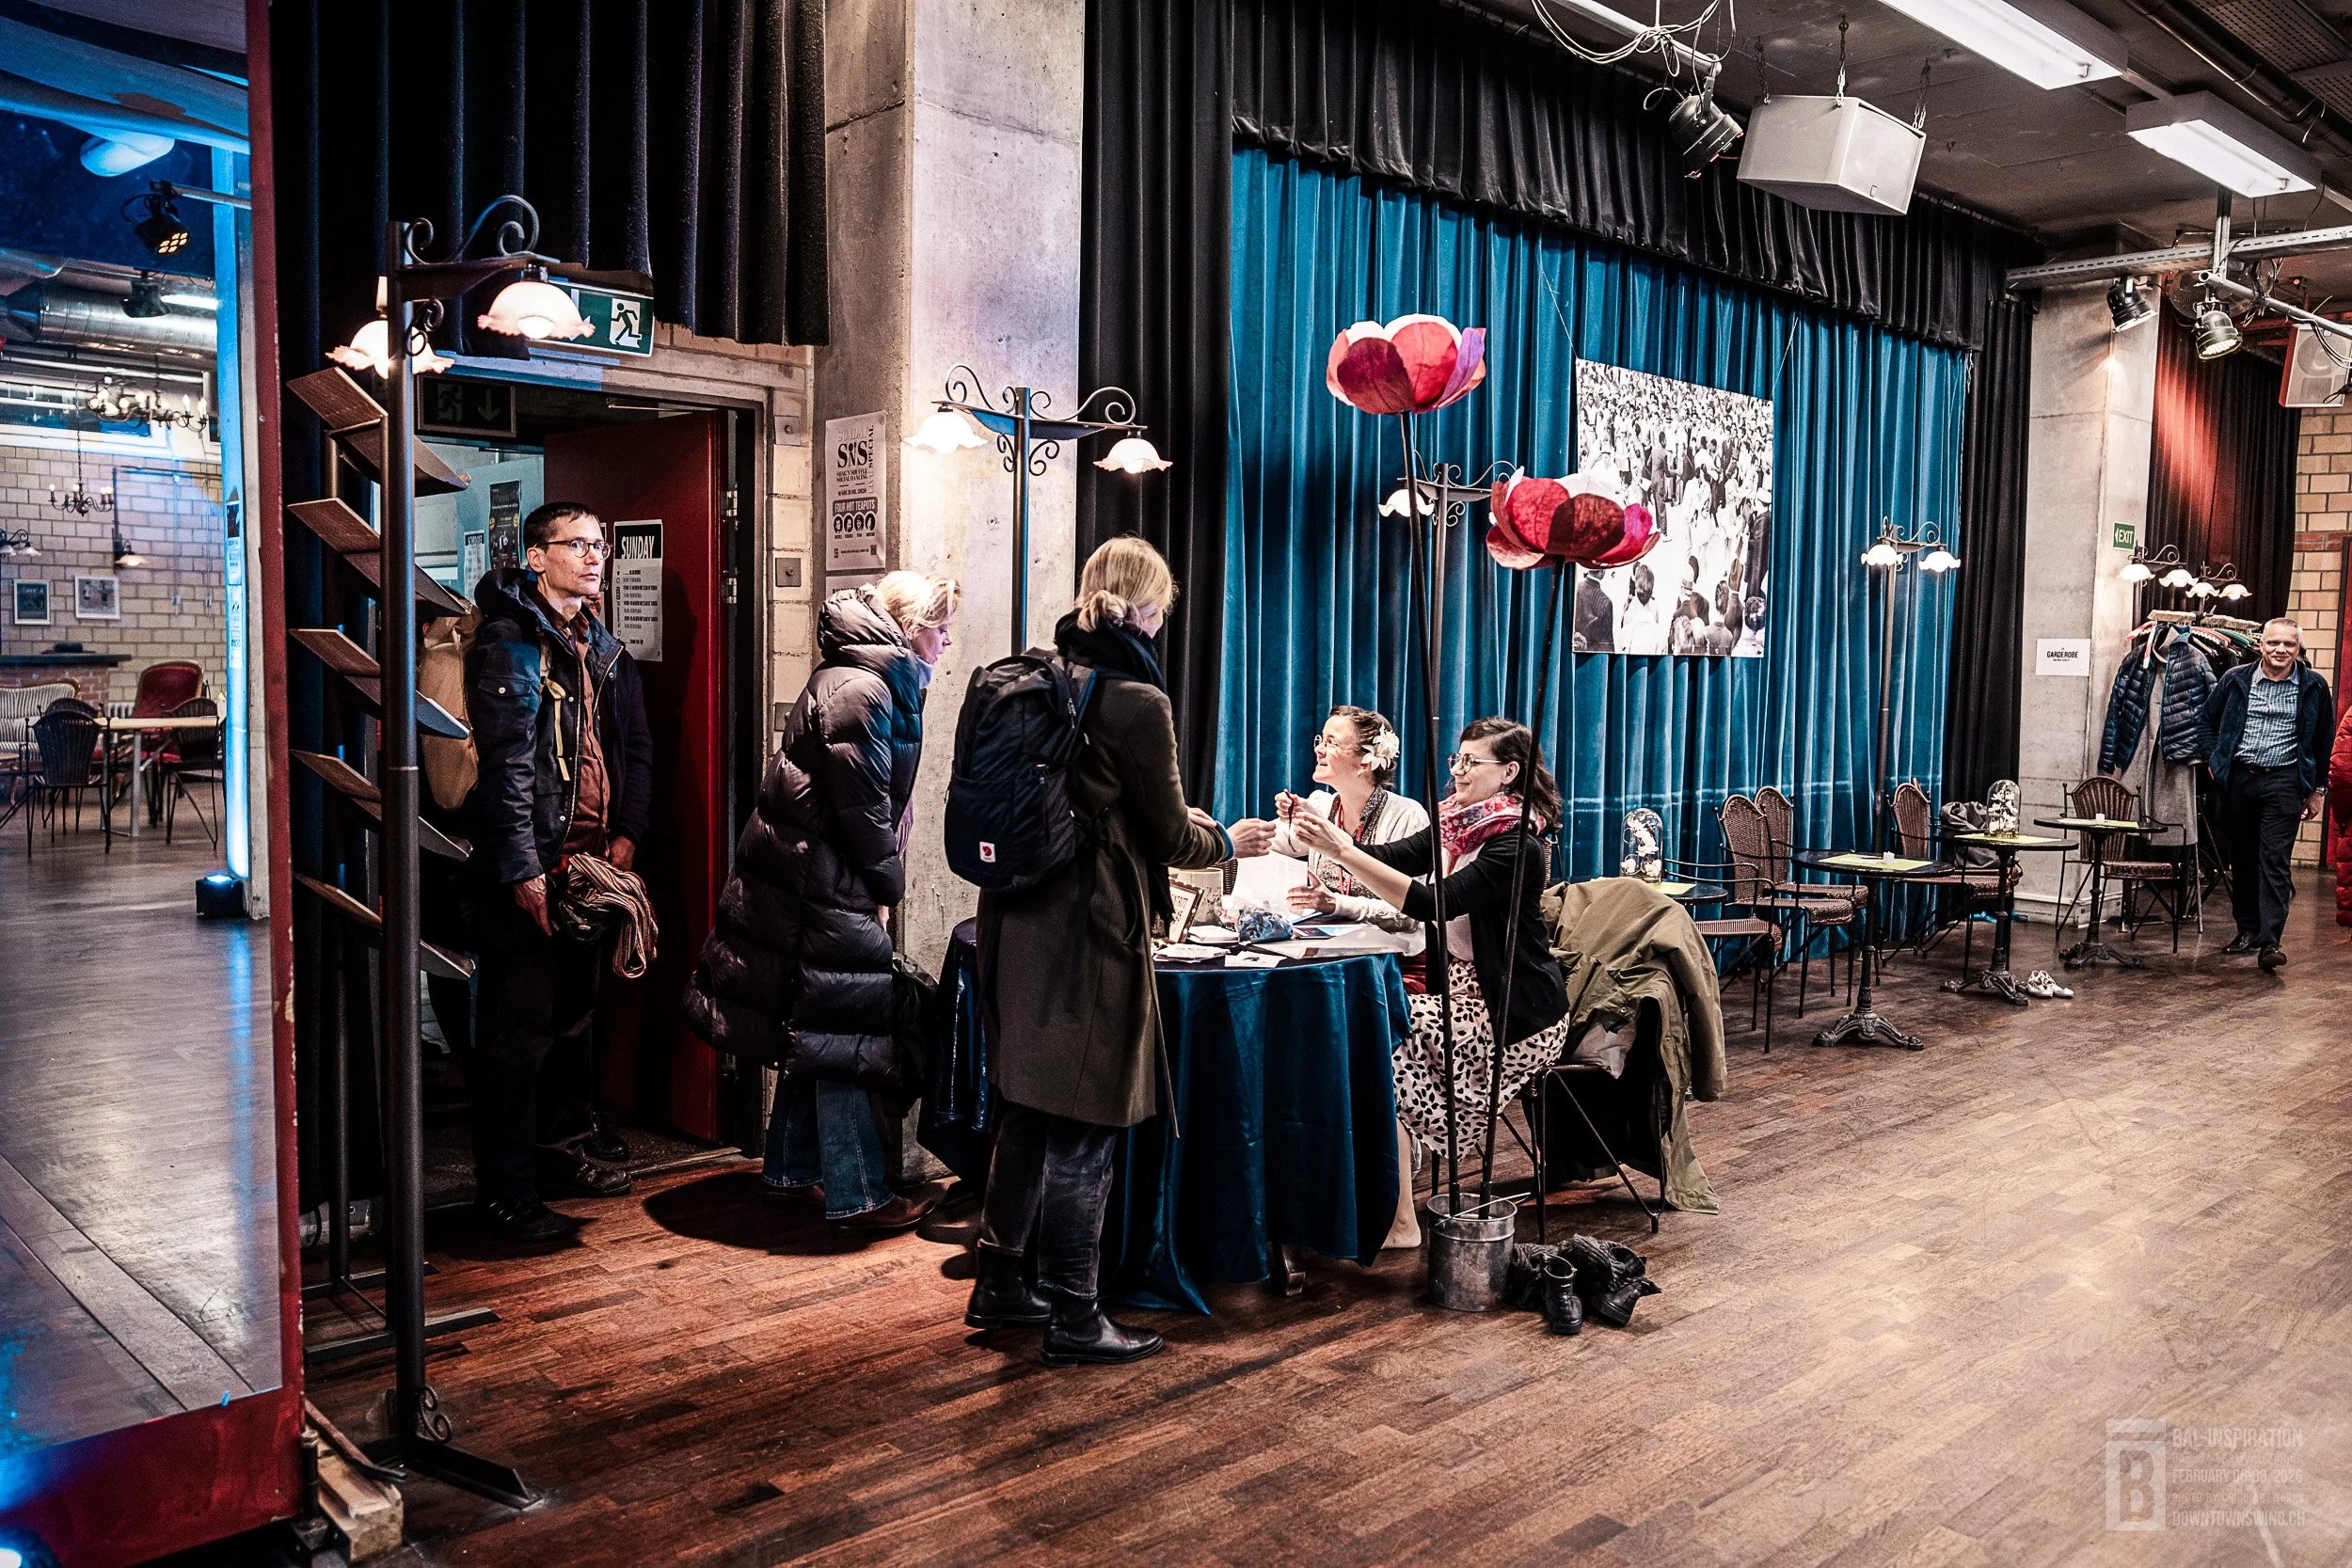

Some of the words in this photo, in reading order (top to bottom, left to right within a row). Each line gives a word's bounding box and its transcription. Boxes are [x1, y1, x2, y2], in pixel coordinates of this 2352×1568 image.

[834, 501, 845, 513] FOUR
[846, 500, 854, 512] HOT
[855, 499, 876, 511] TEAPOTS
[2119, 529, 2134, 544] EXIT
[621, 535, 655, 559] SUNDAY
